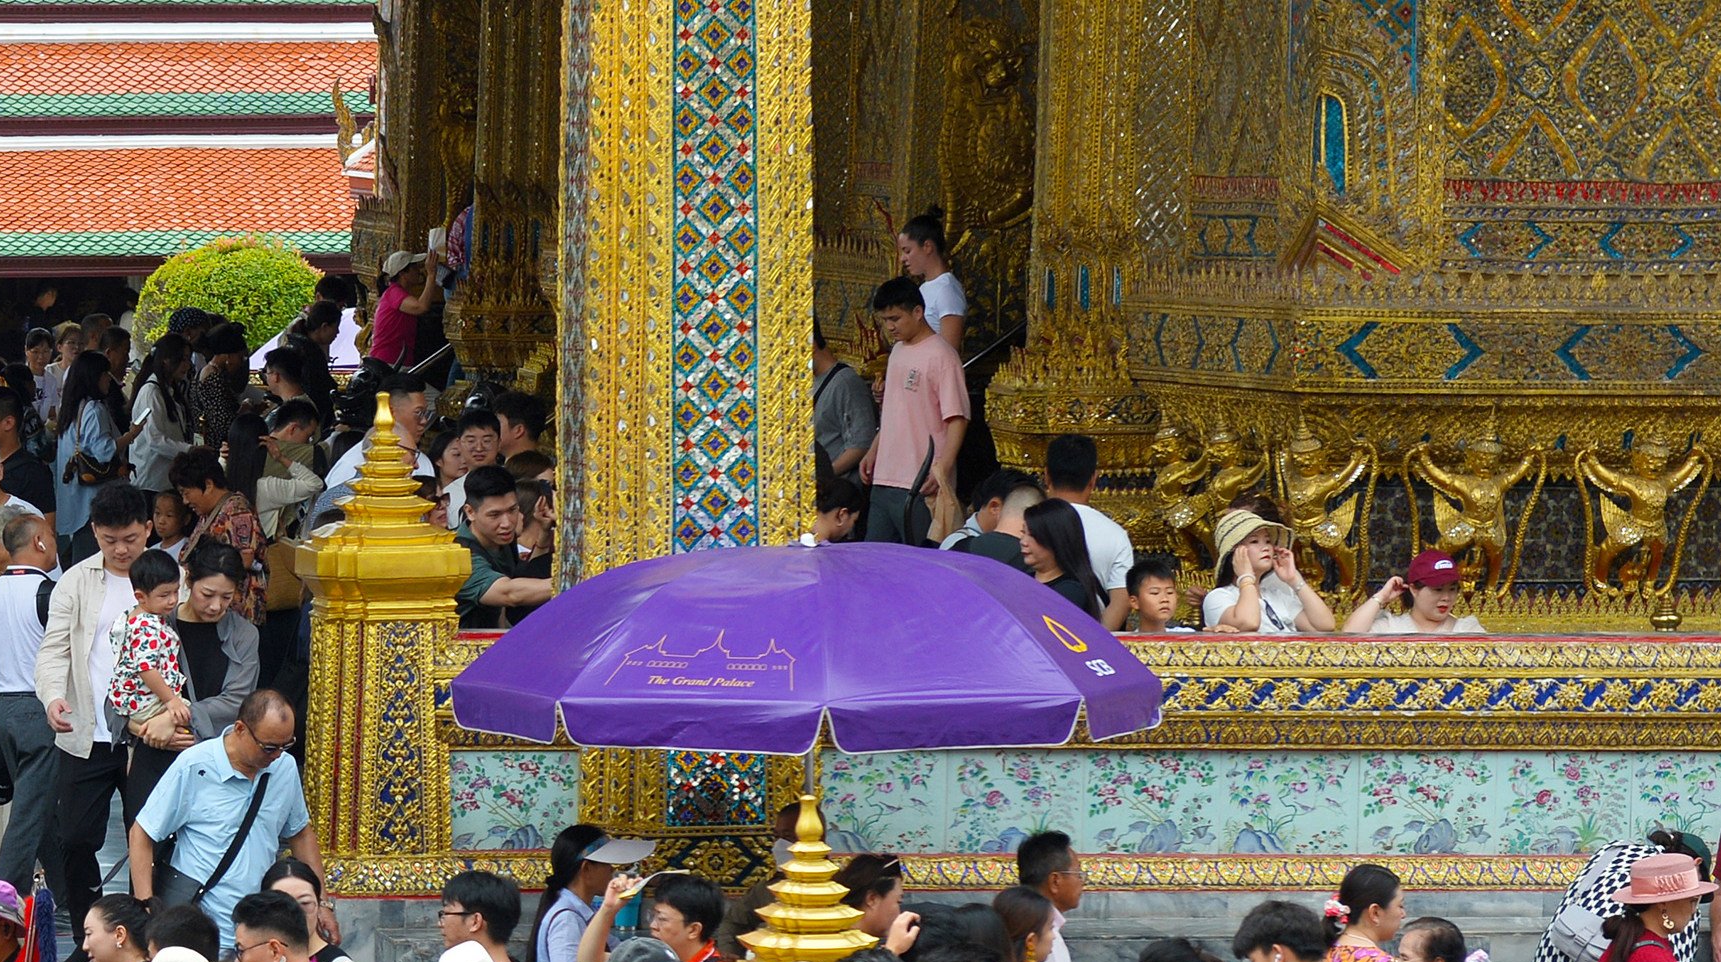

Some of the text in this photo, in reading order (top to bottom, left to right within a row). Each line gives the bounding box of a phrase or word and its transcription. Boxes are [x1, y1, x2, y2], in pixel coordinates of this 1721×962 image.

[1084, 659, 1116, 677] SCB
[647, 675, 756, 688] The Grand Palace
